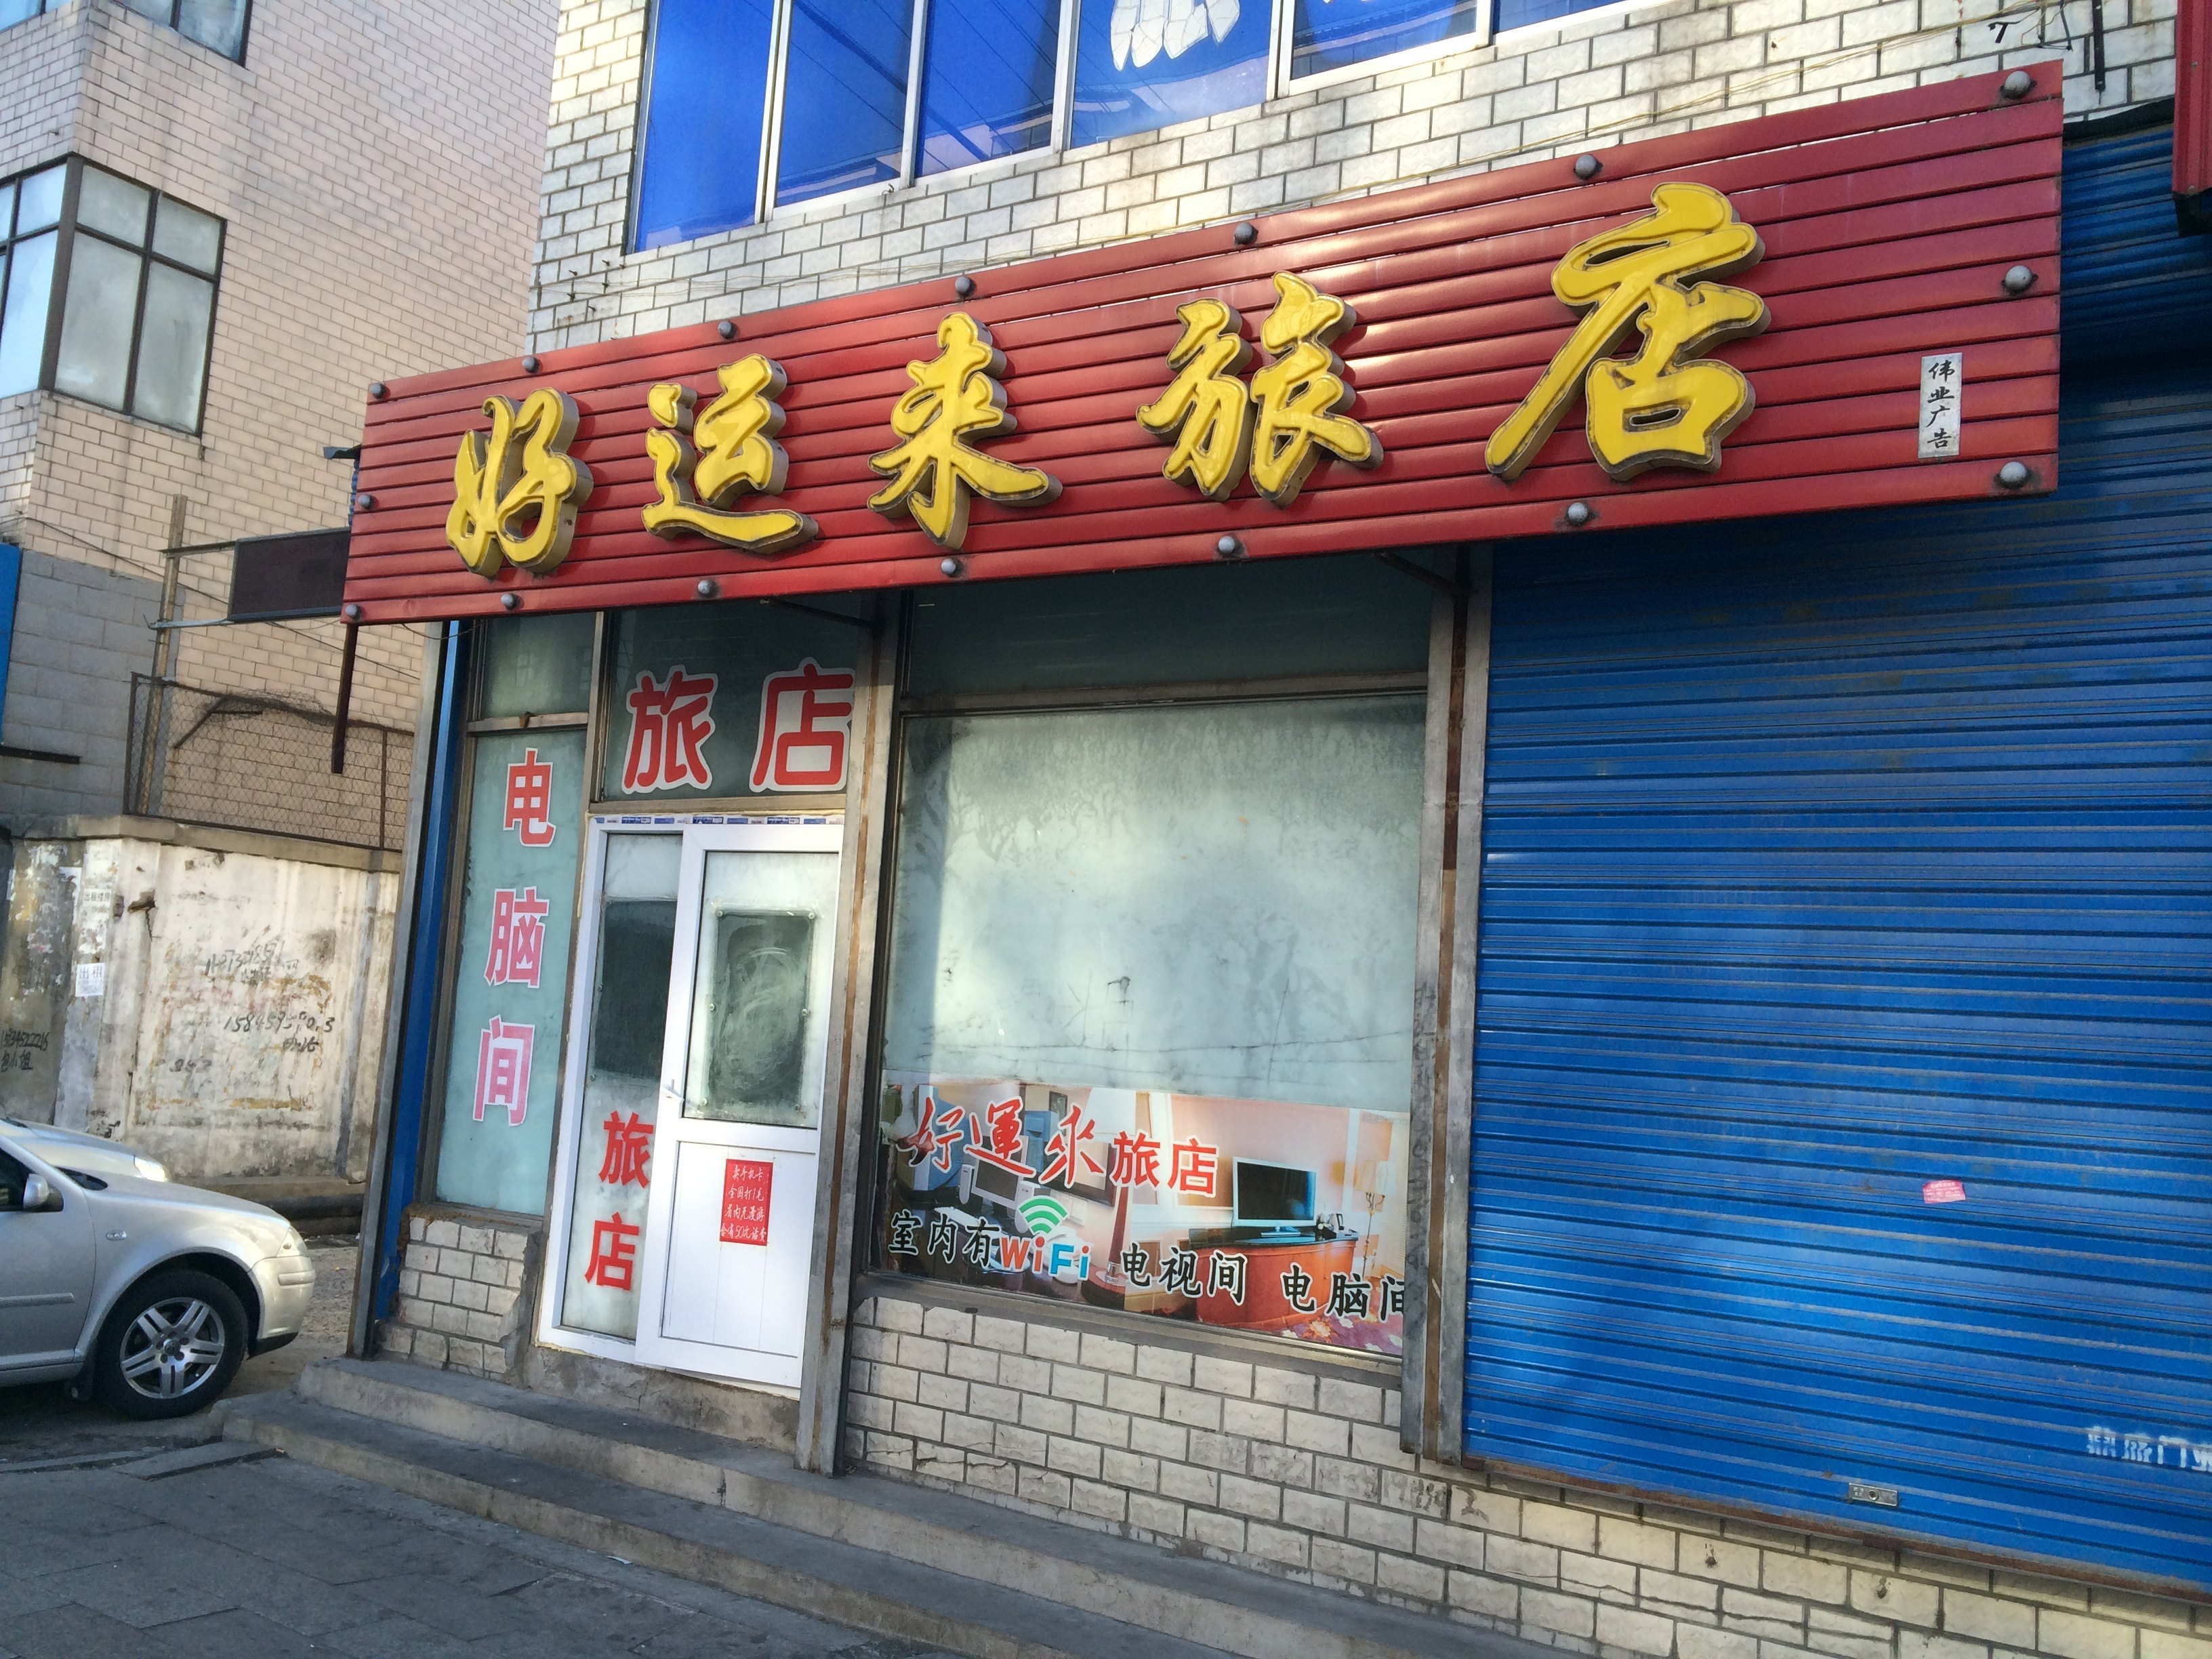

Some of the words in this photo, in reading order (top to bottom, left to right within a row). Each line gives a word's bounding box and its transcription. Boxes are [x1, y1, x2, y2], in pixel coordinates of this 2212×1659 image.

[446, 182, 1771, 579] 好运来旅店
[1927, 359, 1956, 450] 伟业广告
[622, 658, 855, 793] 旅店
[79, 965, 102, 980] 出租
[473, 747, 556, 1126] 电脑间
[584, 1110, 655, 1291] 旅店
[728, 1183, 764, 1202] 全国打1毛
[732, 1164, 764, 1181] 卖手机卡
[1120, 1242, 1248, 1306] 电视间
[1281, 1263, 1404, 1322] 电脑间
